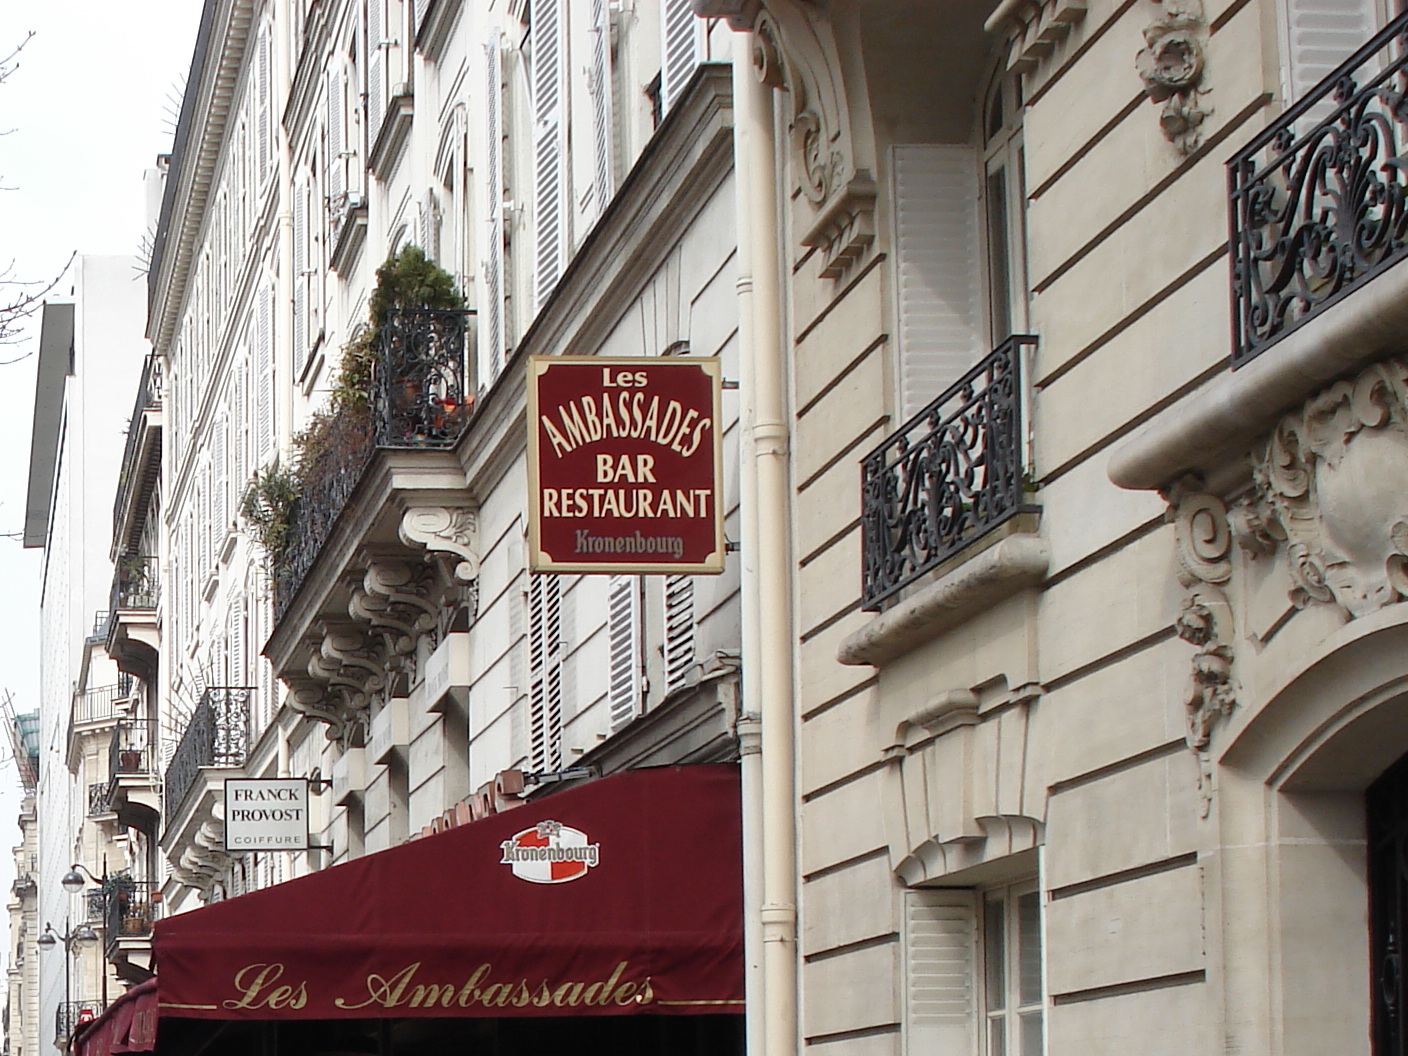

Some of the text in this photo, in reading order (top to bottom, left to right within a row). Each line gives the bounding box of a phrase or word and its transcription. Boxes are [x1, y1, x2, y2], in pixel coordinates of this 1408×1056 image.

[602, 367, 648, 387] Les
[541, 390, 711, 458] AMBASSADES
[596, 454, 657, 483] BAR
[543, 488, 711, 518] RESTAURANT
[574, 529, 684, 559] Kronenbourg
[234, 788, 299, 801] FRANCK
[231, 808, 303, 822] PROVOST
[234, 835, 301, 844] COIFFURE
[501, 841, 599, 867] Kronenbourg
[221, 960, 655, 1010] Les Ambassades
